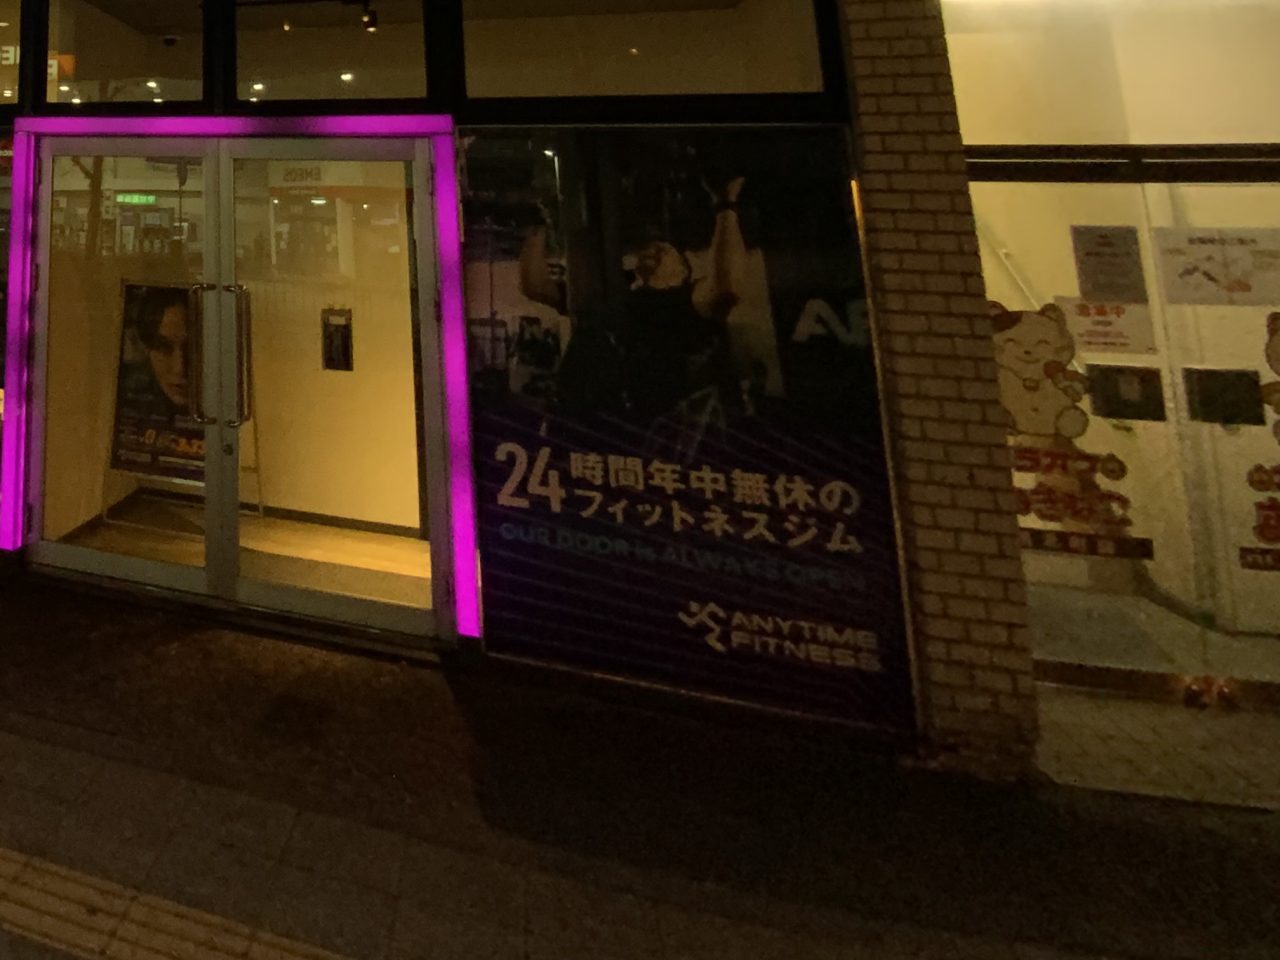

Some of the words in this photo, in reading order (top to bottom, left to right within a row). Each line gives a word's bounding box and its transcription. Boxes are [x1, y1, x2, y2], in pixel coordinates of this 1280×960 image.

[573, 488, 863, 554] フィットネスジム
[730, 610, 880, 650] ANYTIME
[730, 630, 883, 672] FITNESS
